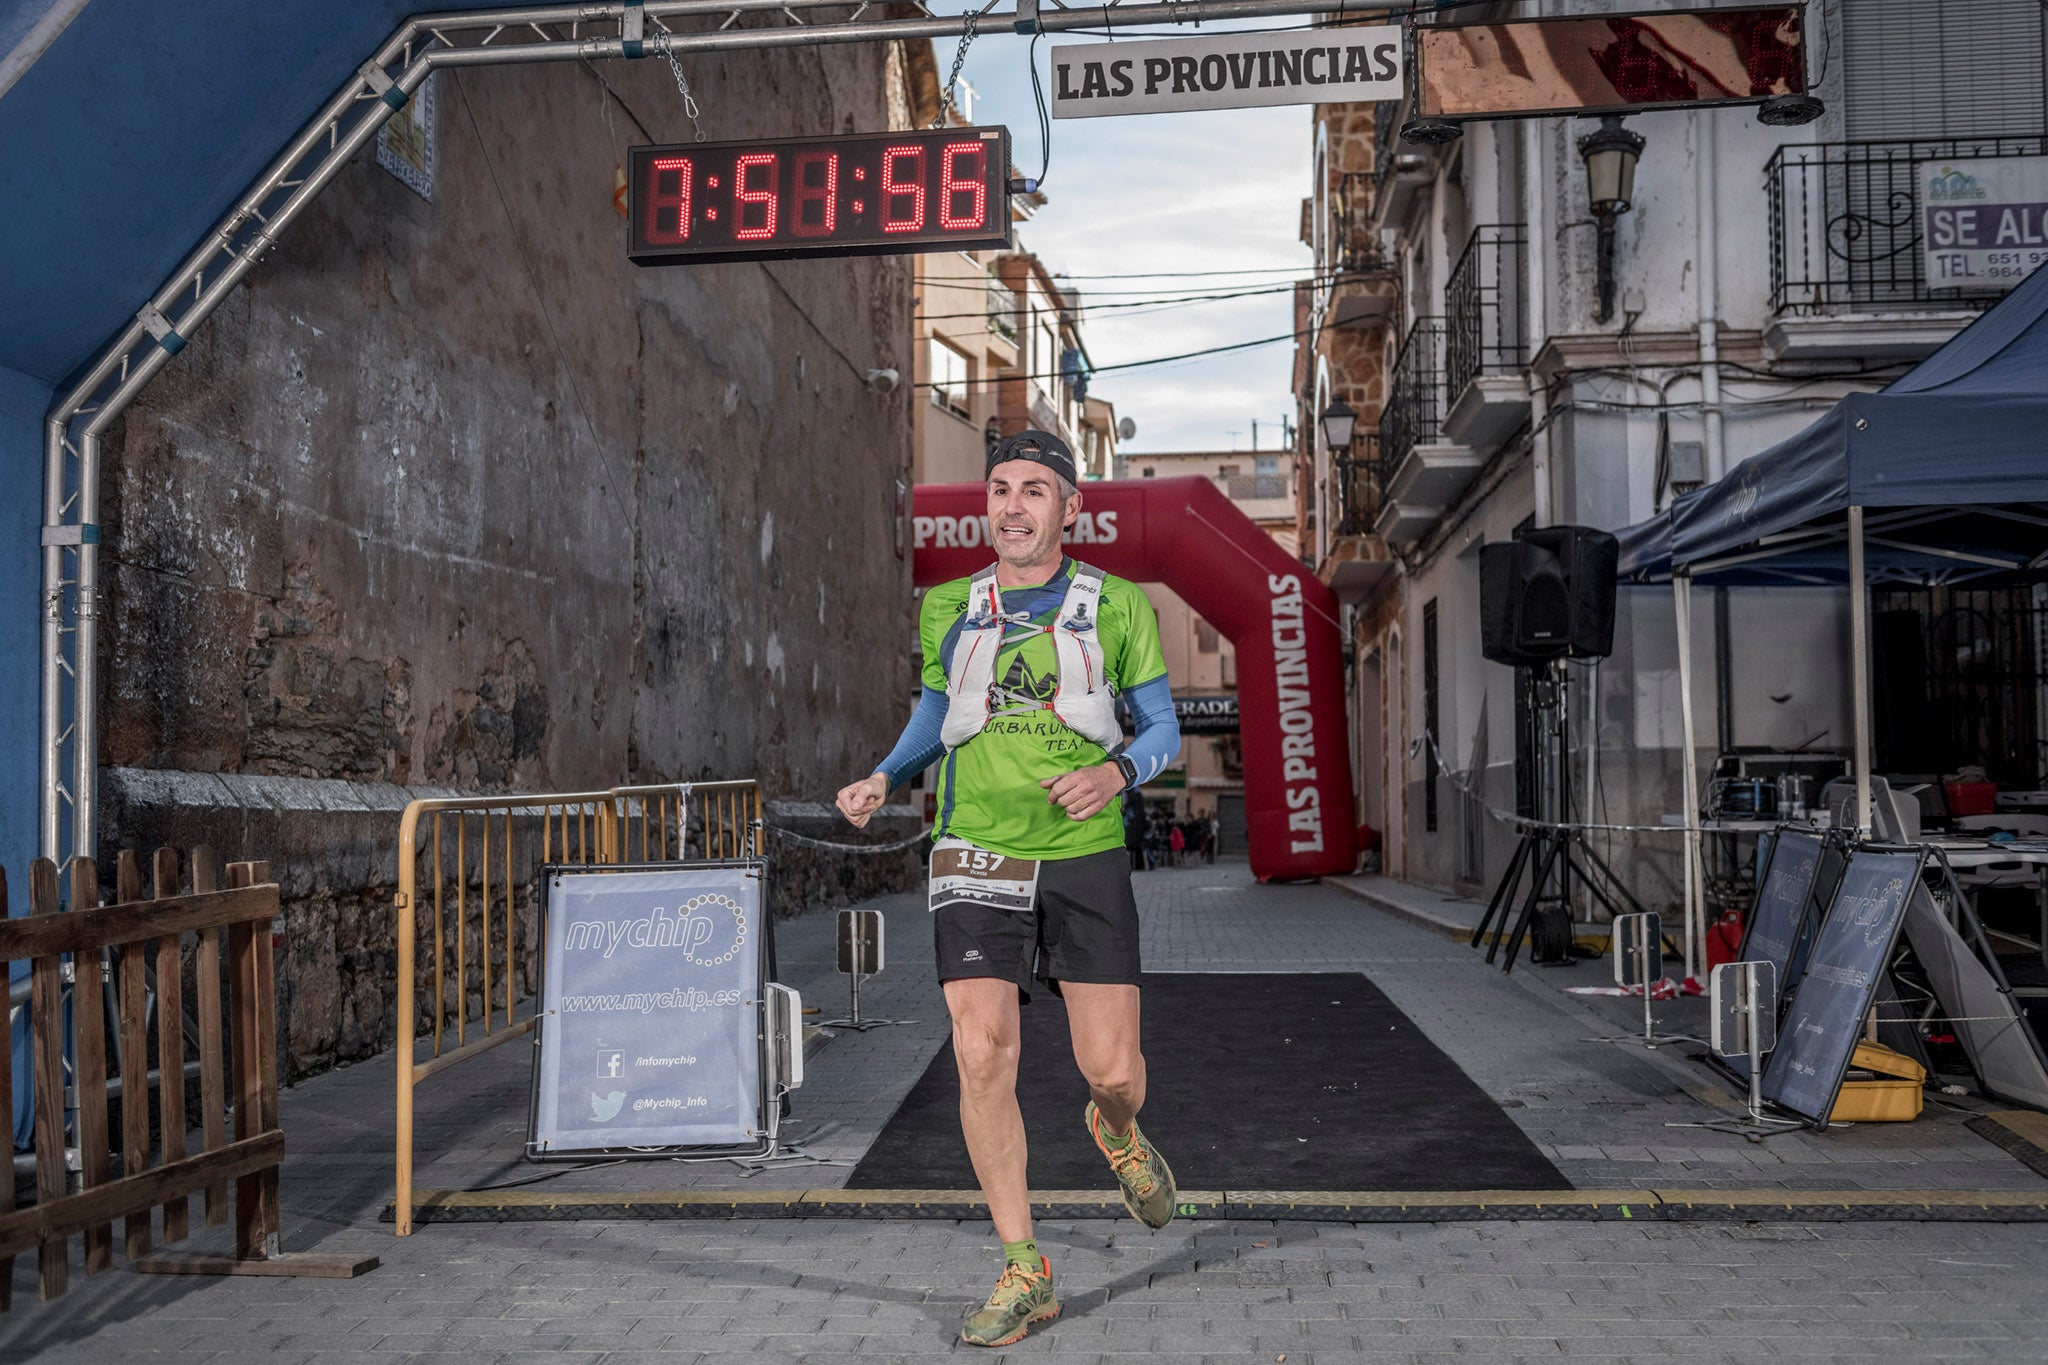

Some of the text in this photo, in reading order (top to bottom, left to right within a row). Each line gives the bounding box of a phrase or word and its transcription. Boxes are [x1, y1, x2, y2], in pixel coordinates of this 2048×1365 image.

[1057, 44, 1397, 100] LAS PROVINCIAS
[652, 142, 986, 240] 7:51:56
[1934, 209, 1978, 246] SE
[1988, 252, 2021, 264] 651
[1988, 266, 2024, 278] 964
[954, 600, 969, 614] JO
[1267, 574, 1325, 854] LAS PROVINCIAS
[984, 721, 1074, 736] URBARUN
[957, 850, 1005, 871] 157
[969, 868, 988, 877] Vicente
[564, 907, 714, 958] mychip
[561, 987, 741, 1014] www.mychip.es
[635, 1054, 697, 1067] /infomychip
[632, 1095, 708, 1110] @Mychip_Info
